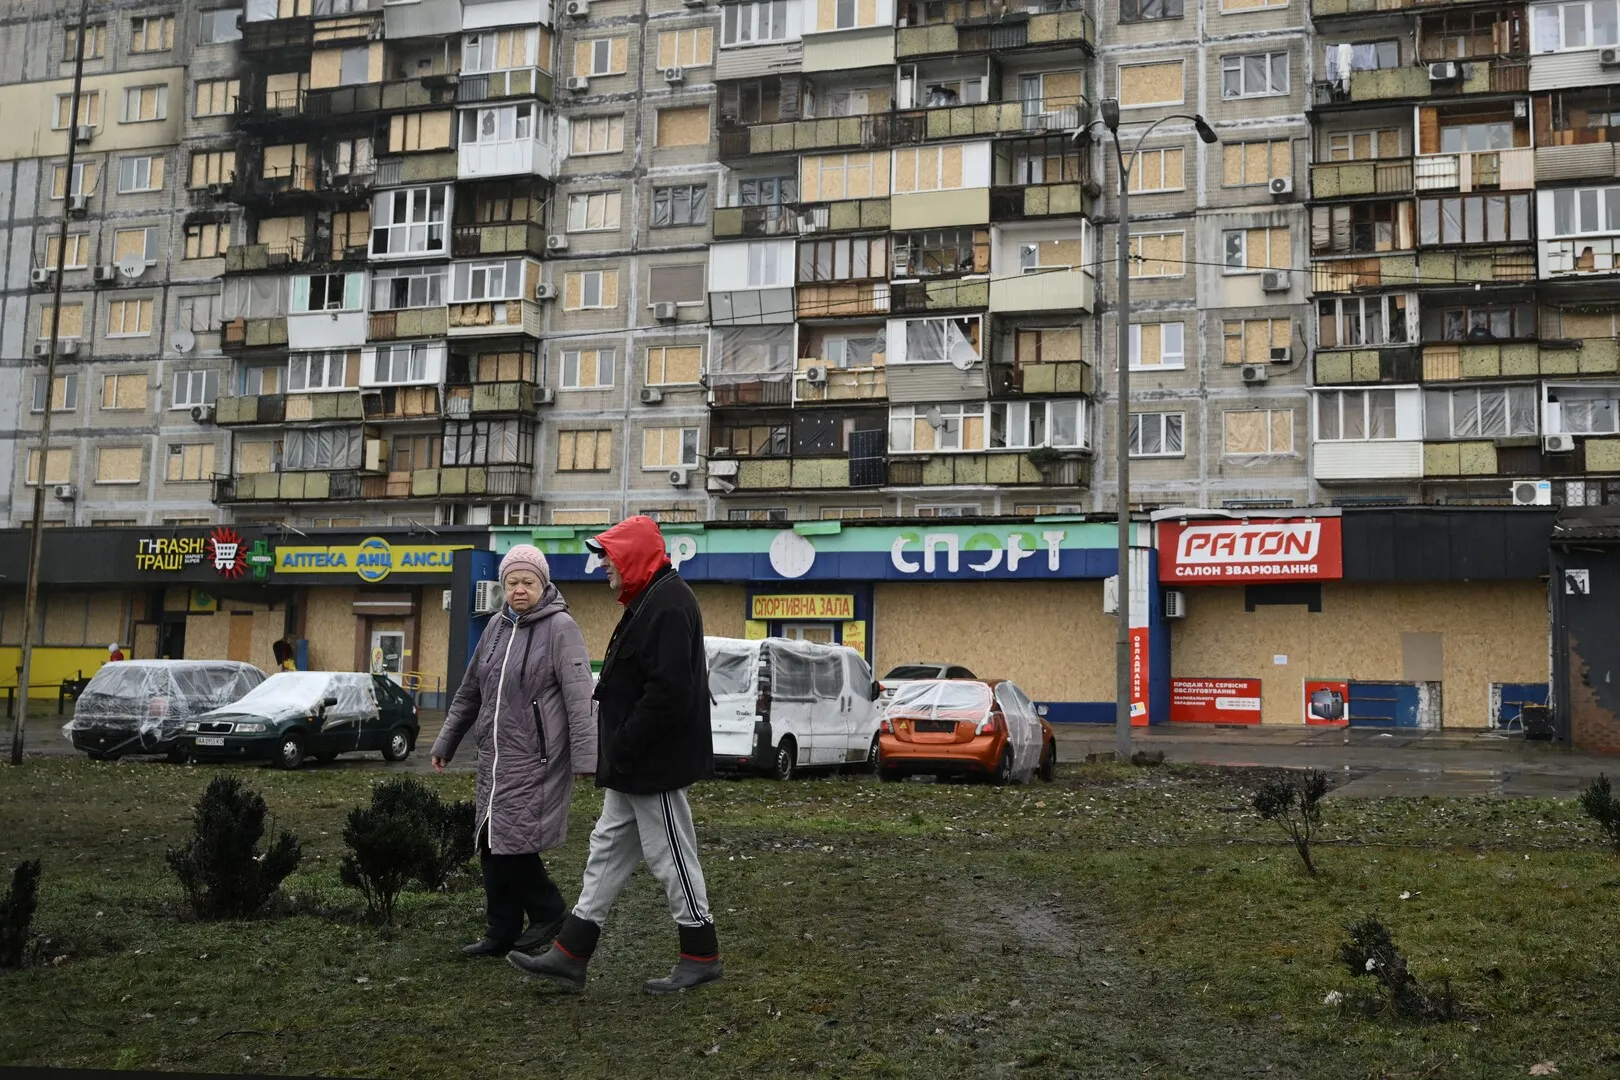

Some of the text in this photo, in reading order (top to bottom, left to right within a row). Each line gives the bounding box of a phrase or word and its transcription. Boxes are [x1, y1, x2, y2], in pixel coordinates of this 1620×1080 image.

[891, 531, 1068, 574] СПОРТ
[1184, 531, 1313, 557] PATON
[136, 554, 183, 570] ТРАШ!
[282, 551, 392, 568] АПТЕКА АНЦ
[1175, 564, 1318, 577] САЛОН ЗВАРЮВАННЯ
[754, 596, 851, 616] СПОРТИВНА ЗАЛА
[1133, 635, 1141, 698] ОБЛАДНАННЯ
